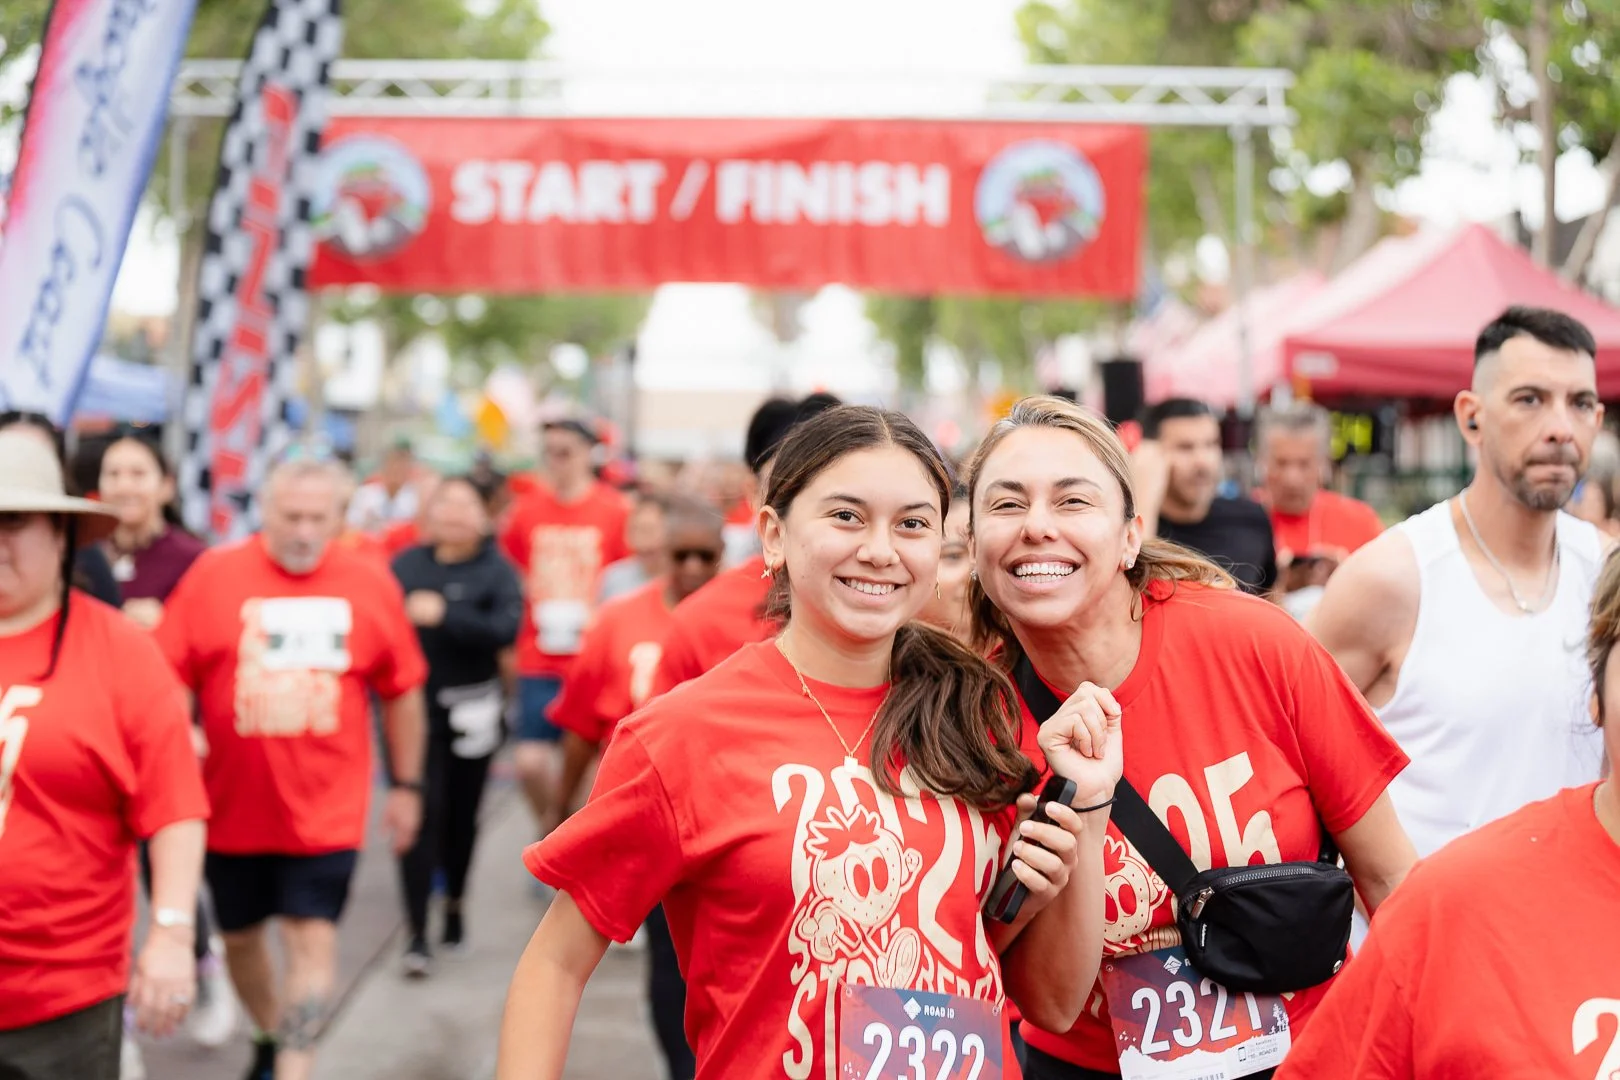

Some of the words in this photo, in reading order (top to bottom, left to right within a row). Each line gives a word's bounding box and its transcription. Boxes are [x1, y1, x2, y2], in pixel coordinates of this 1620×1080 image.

[450, 159, 666, 224] START
[715, 159, 950, 226] FINISH
[924, 1005, 946, 1018] ROAD
[947, 1008, 955, 1019] ID
[1131, 976, 1263, 1055] 2321
[863, 1022, 985, 1080] 2322
